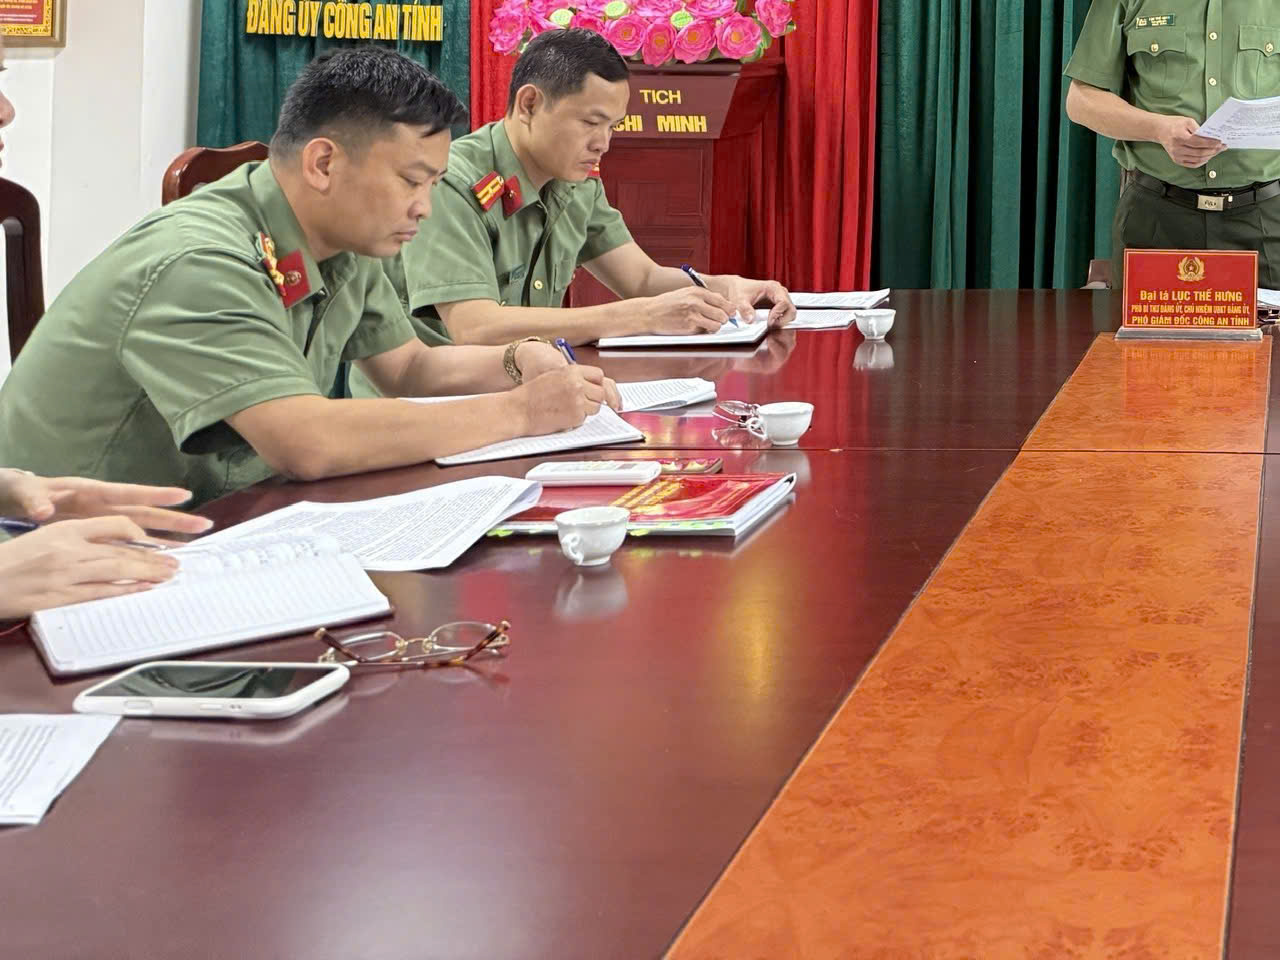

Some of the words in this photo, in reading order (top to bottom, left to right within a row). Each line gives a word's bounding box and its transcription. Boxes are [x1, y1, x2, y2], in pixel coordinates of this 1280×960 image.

[373, 3, 400, 40] AN
[657, 115, 708, 132] MINH
[1172, 290, 1191, 303] LỤC
[1193, 288, 1212, 301] THẾ
[1131, 315, 1149, 324] PHÓ
[1151, 315, 1172, 324] GIÁM
[1192, 315, 1215, 325] CÔNG
[1216, 317, 1229, 325] AN
